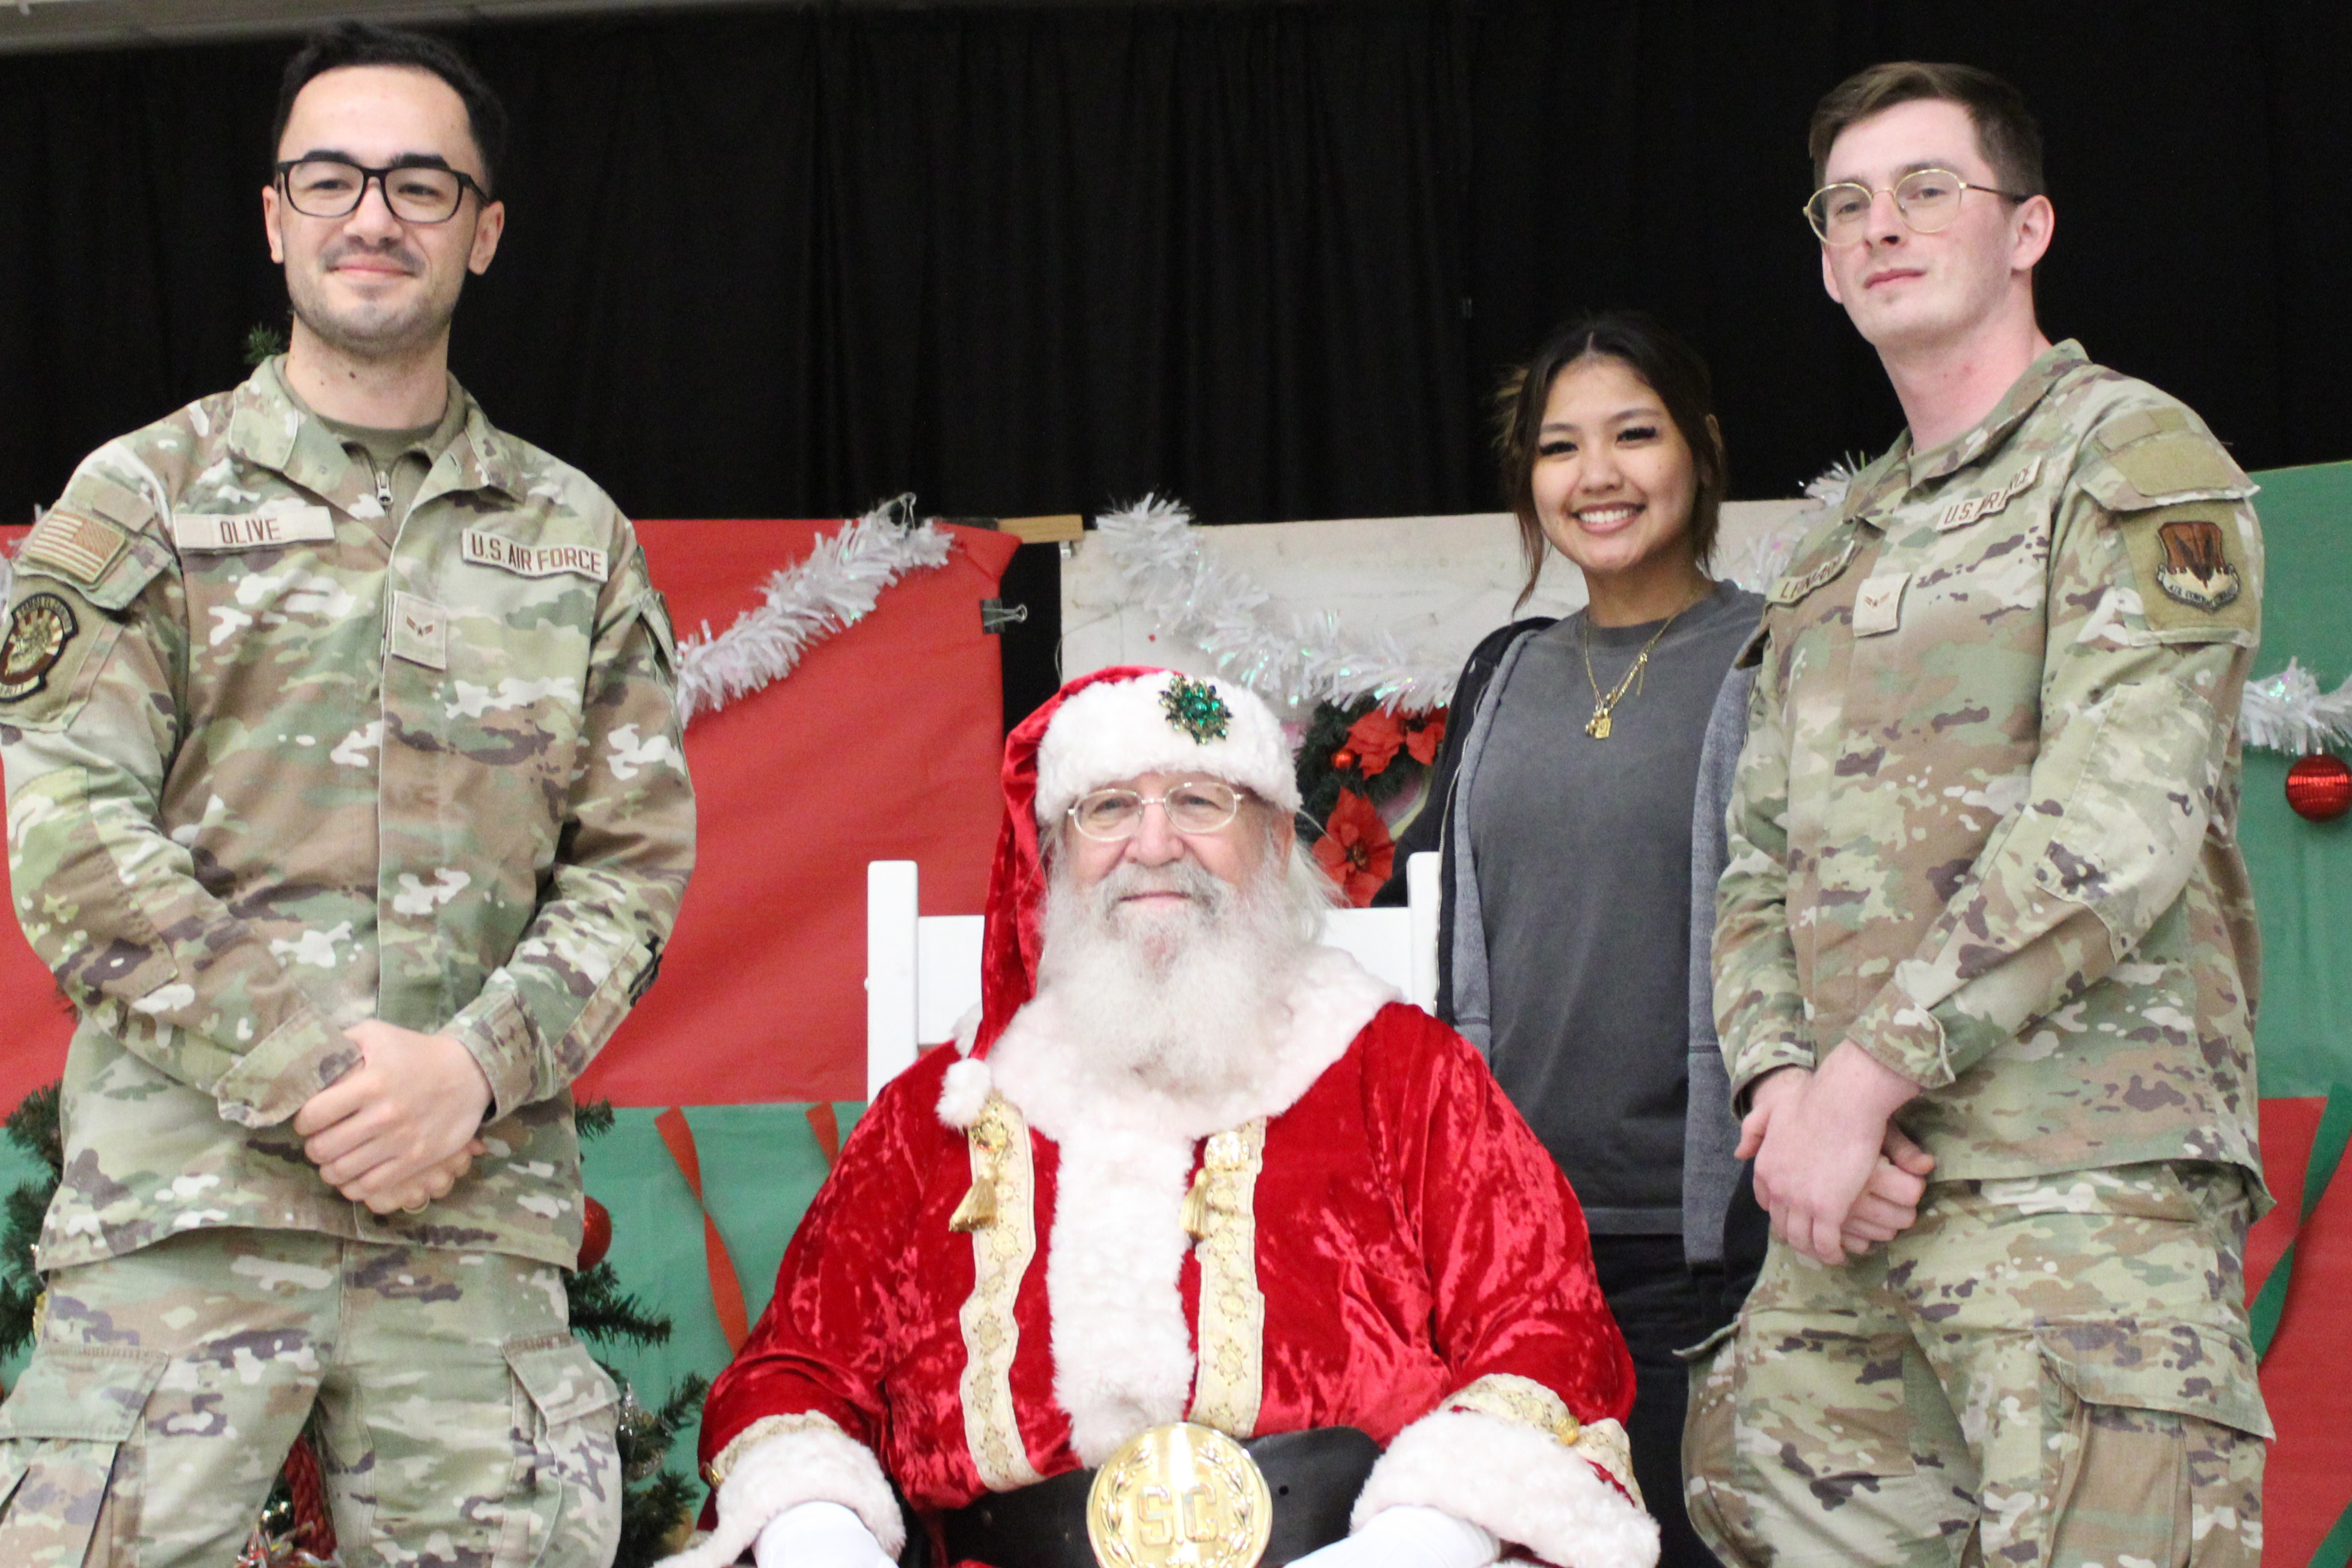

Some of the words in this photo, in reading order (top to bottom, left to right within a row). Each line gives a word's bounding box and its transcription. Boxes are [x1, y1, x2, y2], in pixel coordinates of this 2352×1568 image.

[219, 519, 282, 544] OLIVE
[471, 532, 506, 562] U.S.
[508, 543, 533, 572] AIR
[536, 546, 602, 575] FORCE
